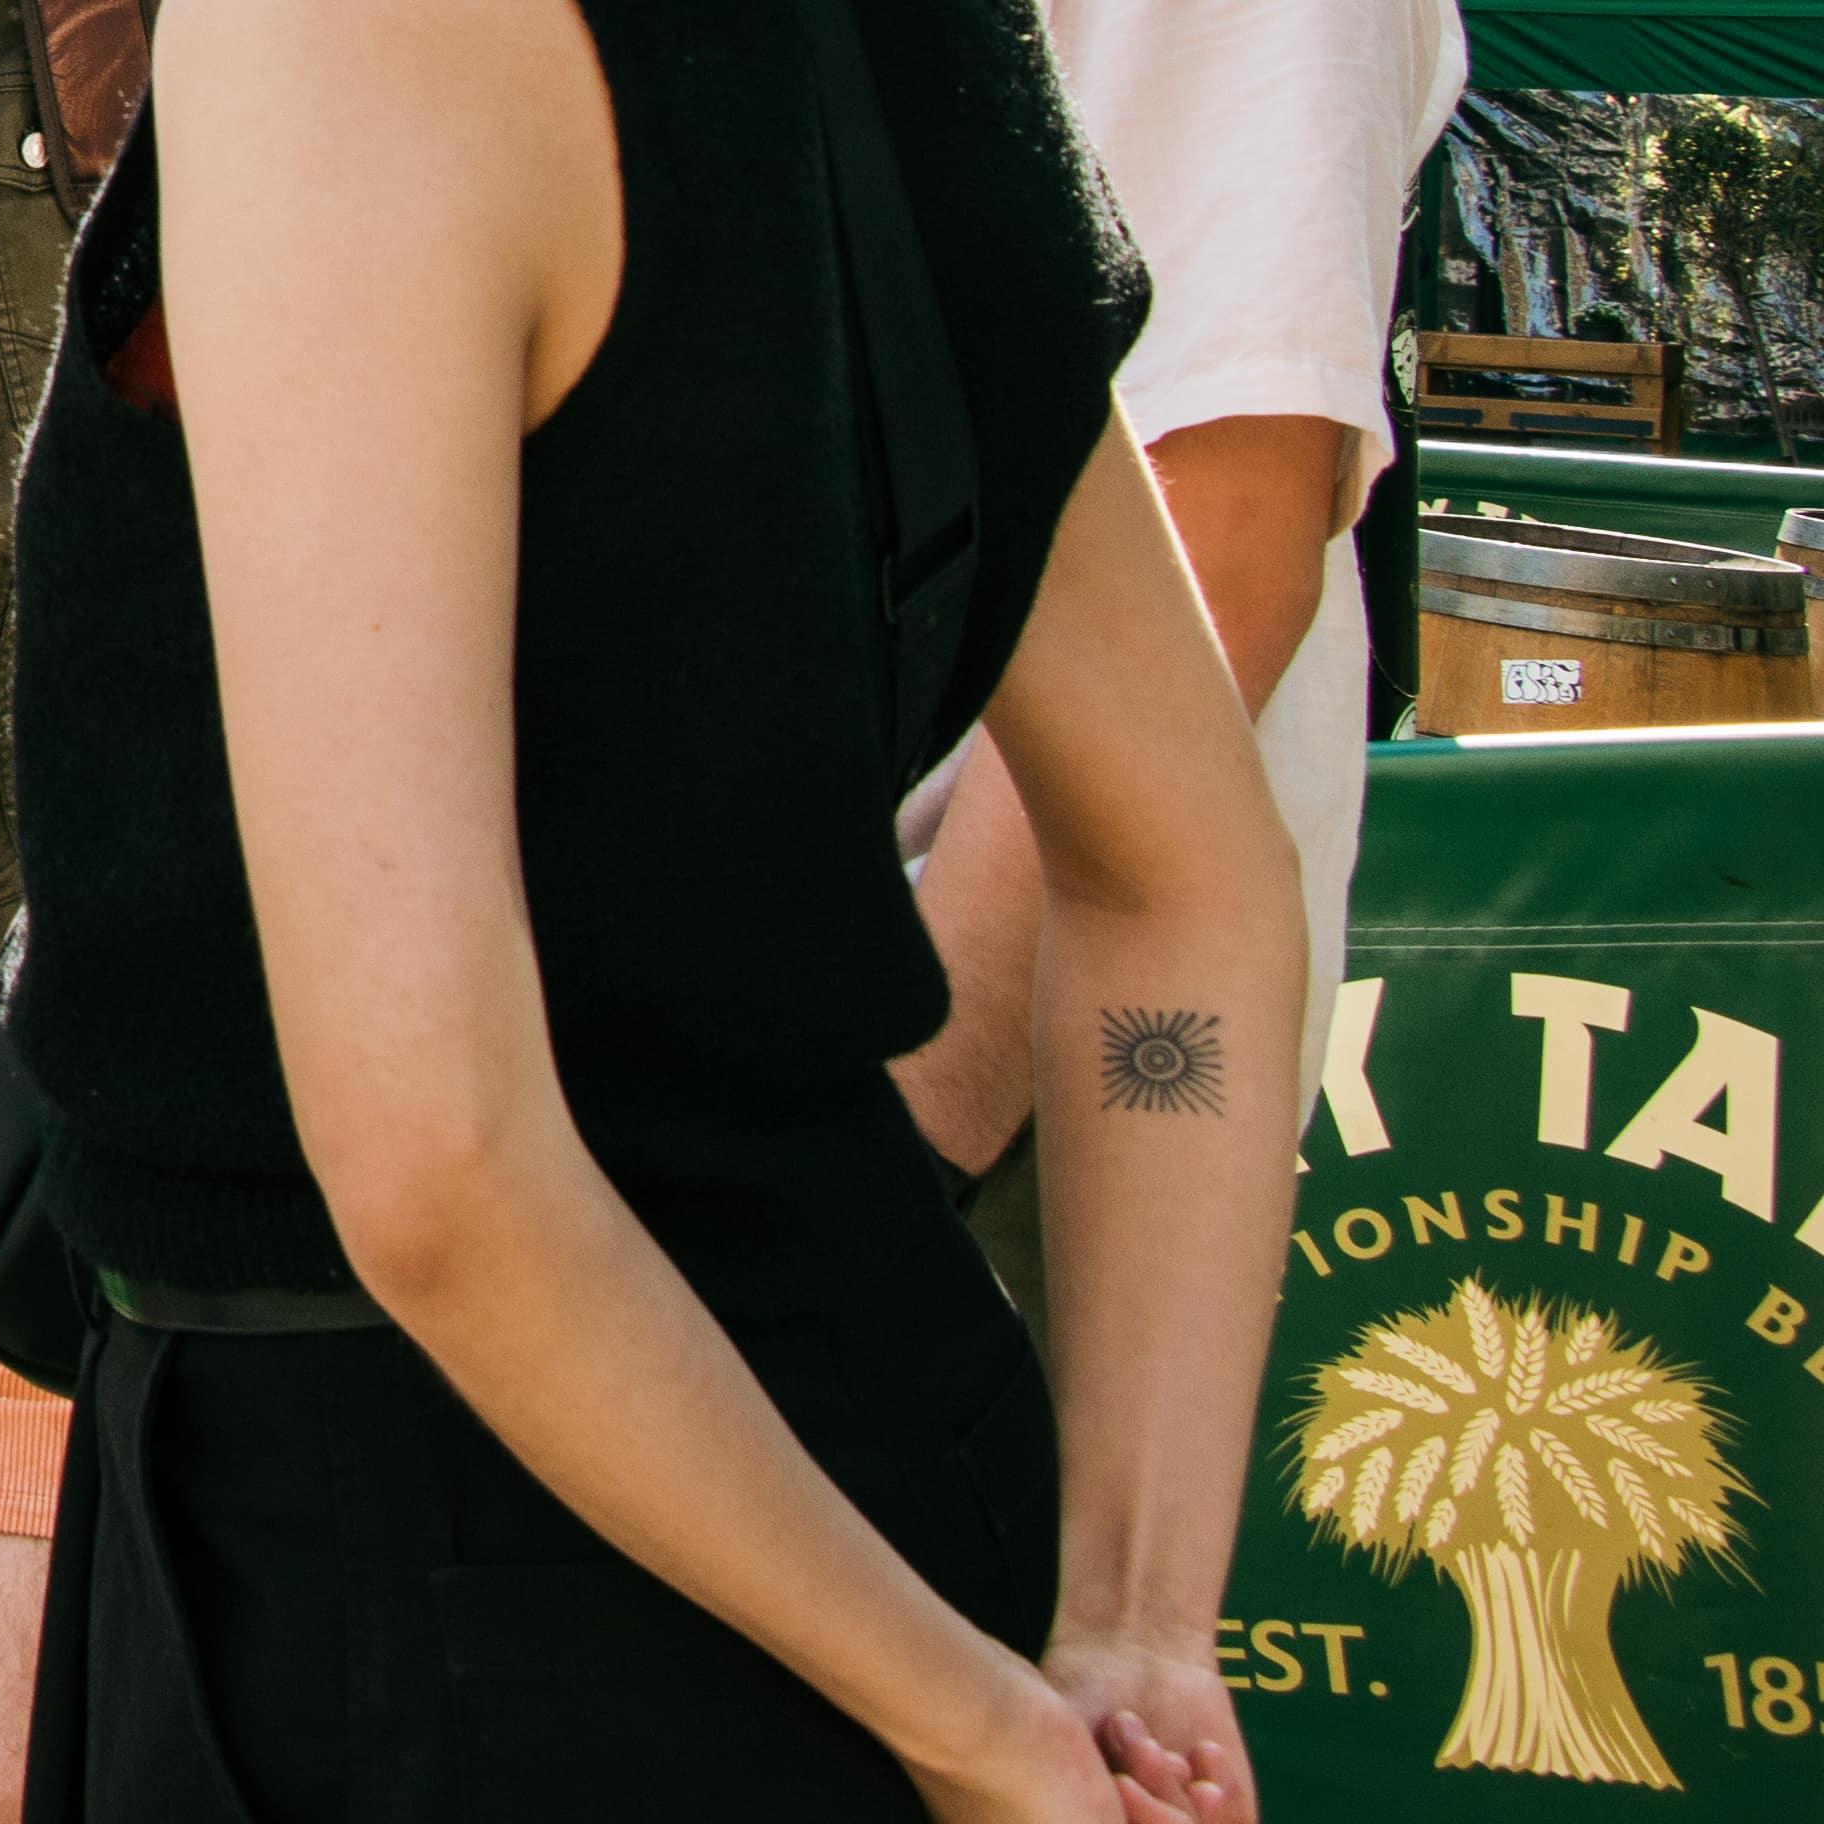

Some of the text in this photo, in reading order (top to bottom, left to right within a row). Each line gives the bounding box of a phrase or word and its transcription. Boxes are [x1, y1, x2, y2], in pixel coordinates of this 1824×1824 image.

[1510, 972, 1824, 1257] TA
[1290, 1188, 1713, 1283] IONSHIP
[1214, 1618, 1391, 1699] EST.
